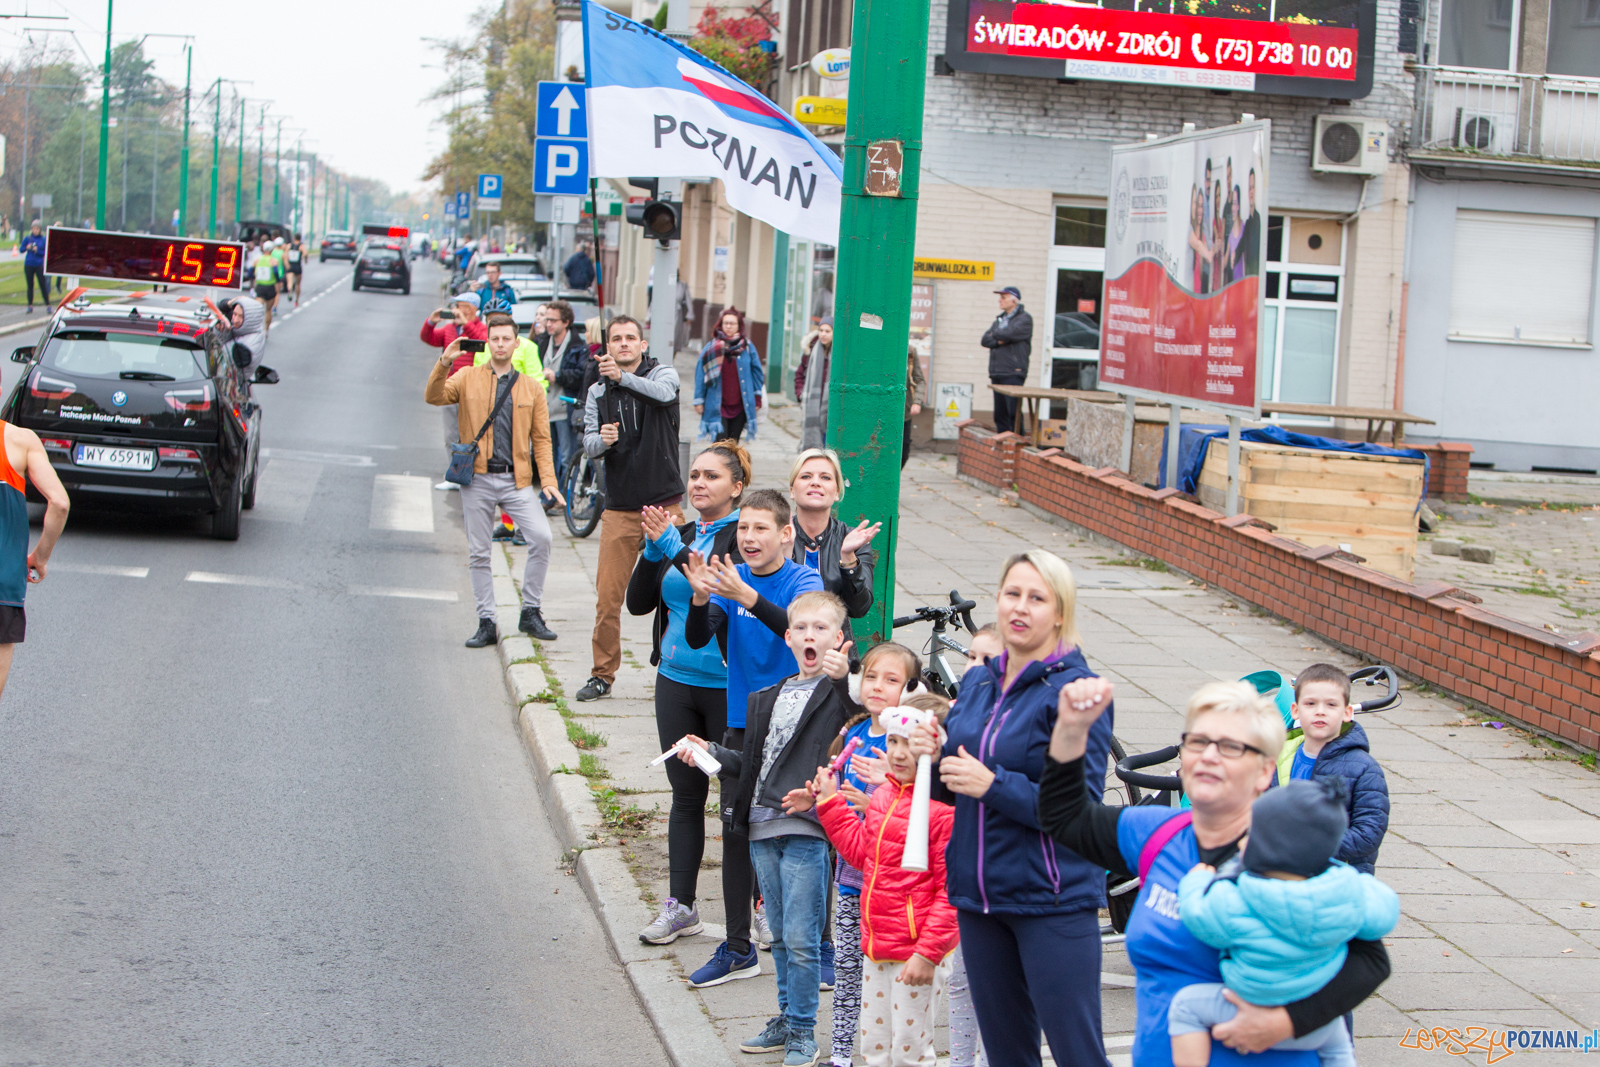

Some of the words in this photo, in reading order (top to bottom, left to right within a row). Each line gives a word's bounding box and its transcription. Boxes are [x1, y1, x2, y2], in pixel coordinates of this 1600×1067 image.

[1215, 38, 1253, 66] (75)
[1257, 41, 1294, 65] 738
[1300, 44, 1321, 66] 10
[1326, 47, 1352, 69] 00
[1068, 62, 1138, 79] ZAREKLAMUJ
[1196, 72, 1214, 84] 693
[1216, 74, 1231, 85] 313
[1233, 75, 1252, 87] 035
[653, 113, 818, 210] POZNAŃ
[870, 146, 883, 164] Z
[546, 144, 579, 188] P
[483, 176, 498, 196] P
[163, 243, 238, 285] 1.53
[981, 265, 991, 276] 11
[913, 286, 929, 295] WA
[60, 409, 92, 421] Inchcape
[92, 412, 114, 423] Motor
[114, 414, 142, 425] Poznań
[86, 448, 105, 461] WY
[109, 449, 151, 465] 6591W
